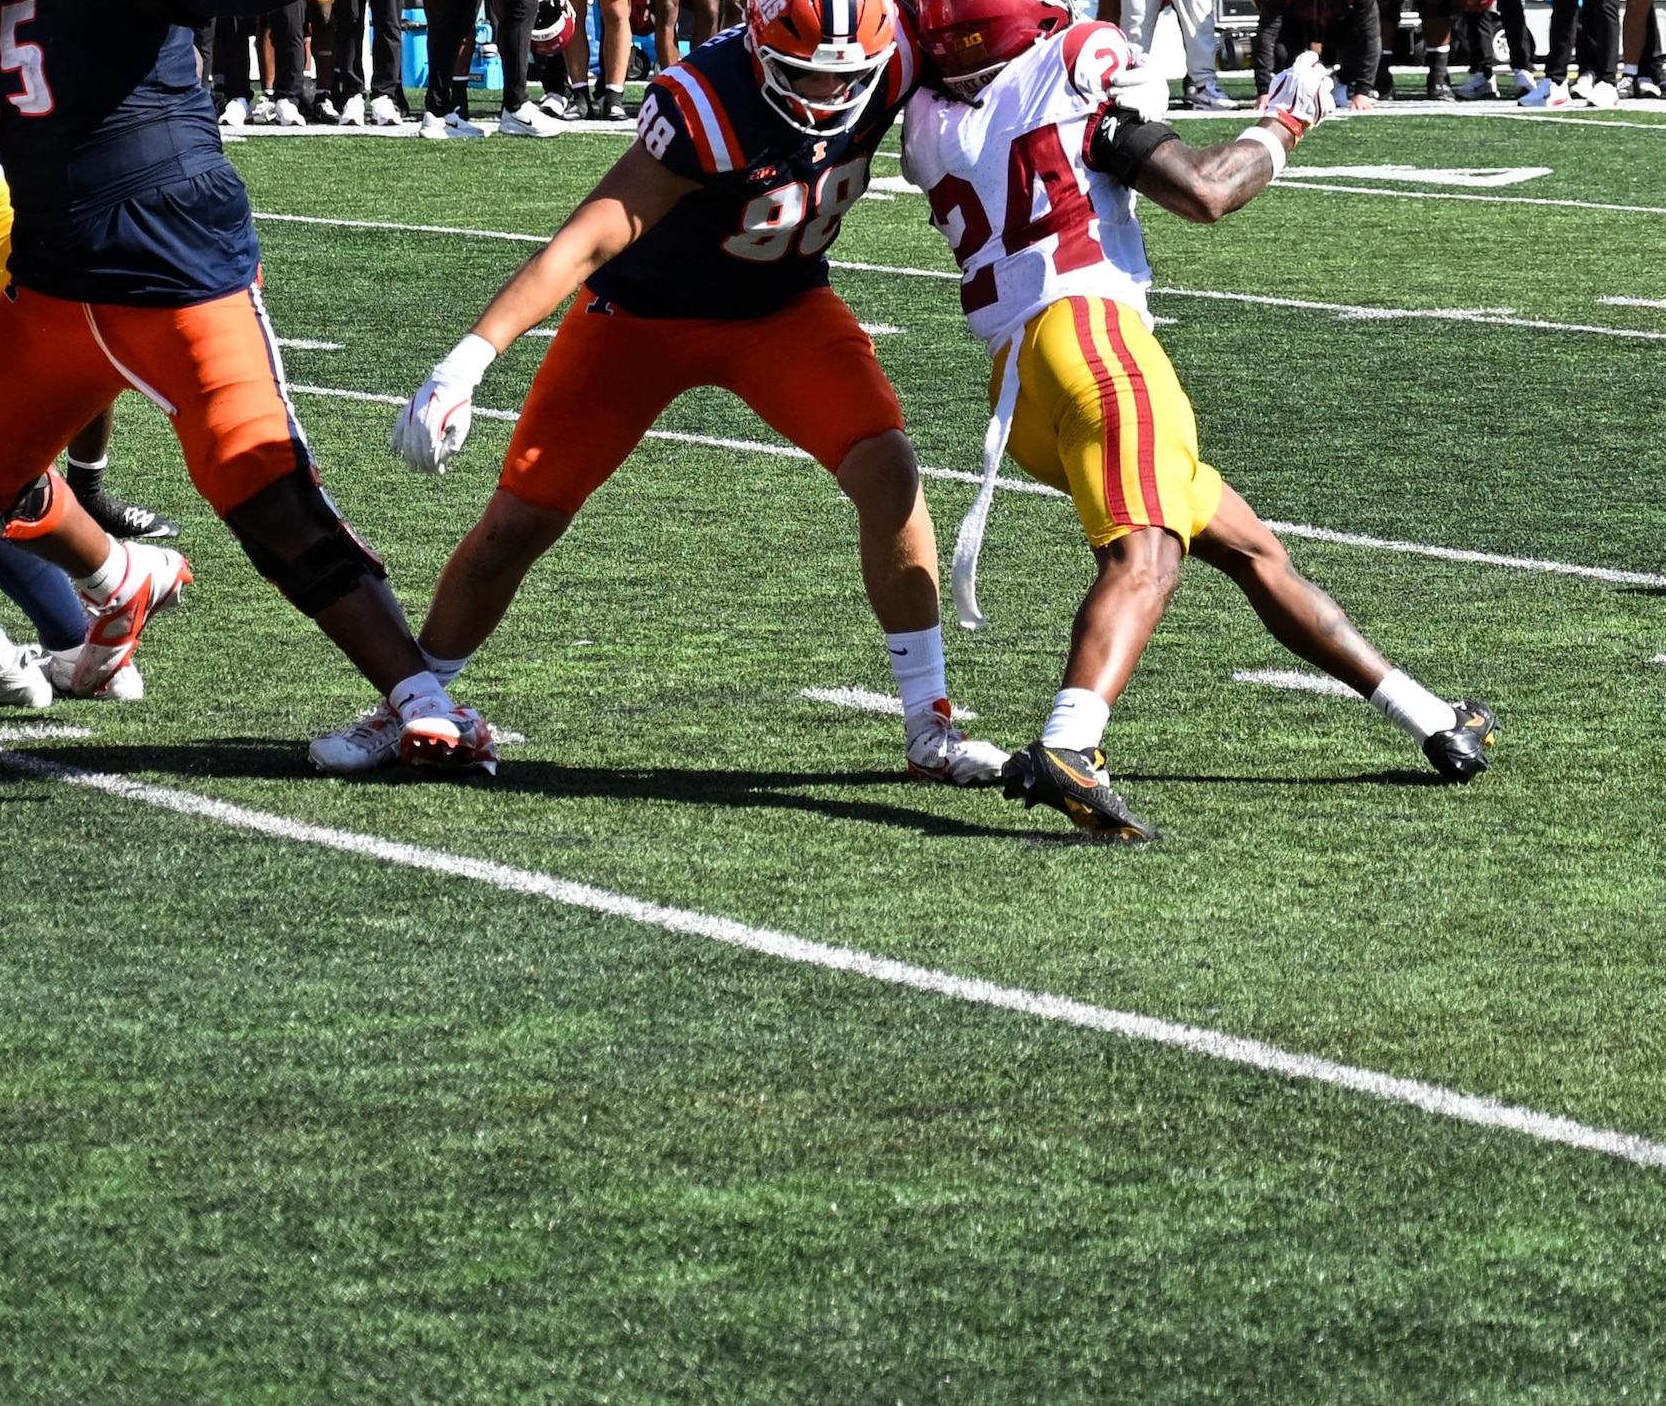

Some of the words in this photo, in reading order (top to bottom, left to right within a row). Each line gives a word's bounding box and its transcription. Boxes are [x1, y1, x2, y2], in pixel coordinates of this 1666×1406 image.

[1093, 48, 1120, 92] 2
[637, 93, 677, 162] 88
[720, 156, 871, 262] 88
[934, 124, 1103, 319] 24
